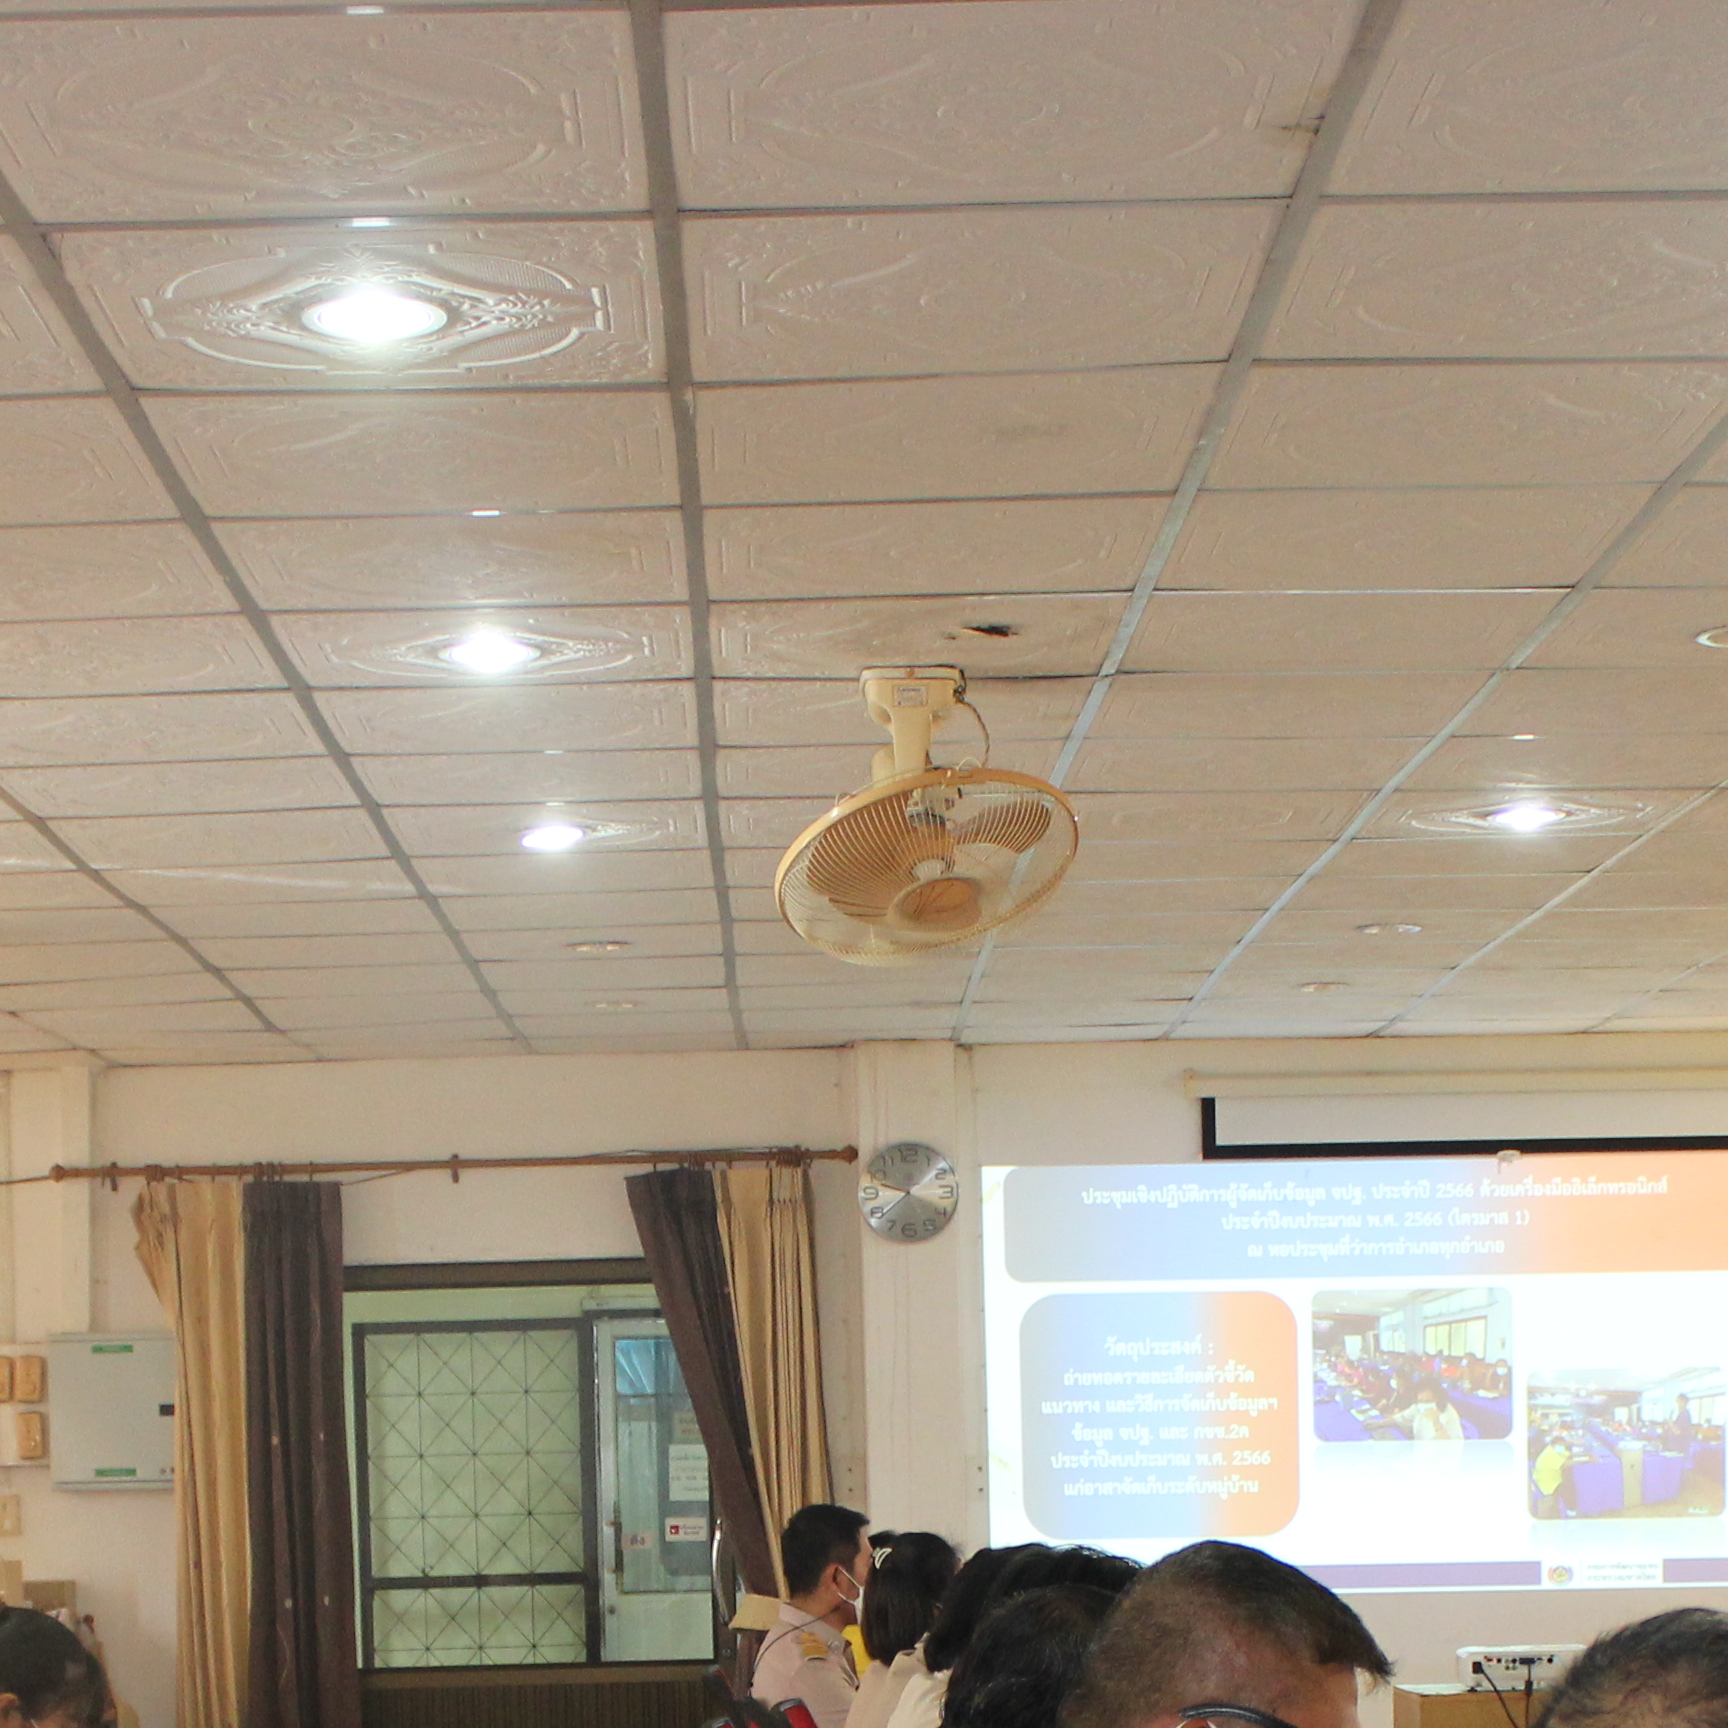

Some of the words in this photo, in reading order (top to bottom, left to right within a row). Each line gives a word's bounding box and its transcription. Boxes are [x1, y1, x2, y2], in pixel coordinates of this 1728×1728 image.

[898, 1148, 919, 1163] 12
[935, 1168, 947, 1180] 2
[863, 1185, 879, 1200] 9
[939, 1184, 954, 1199] 3
[1372, 1180, 1430, 1200] ประจำปี
[1436, 1183, 1474, 1199] 2566
[1480, 1174, 1668, 1198] ด้วยเครื่องมืออิเล็กทรอนิกส์
[934, 1207, 947, 1218] 4
[1221, 1210, 1362, 1230] ประจำปีงบประมาณ
[1368, 1211, 1399, 1228] พ.ศ.
[1404, 1211, 1443, 1227] 2566
[1448, 1206, 1508, 1228] (ไตรมาส
[1514, 1209, 1530, 1227] 1)
[886, 1219, 897, 1232] 7
[901, 1222, 918, 1238] 6
[923, 1219, 937, 1232] 5
[1247, 1244, 1263, 1258] ณ
[1269, 1233, 1505, 1262] หอประชุมที่ว่าการอำเภอทุกอำเภอ
[1105, 1335, 1202, 1361] วัตถุประสงค์
[1064, 1360, 1254, 1385] ถ่ายทอดรายละเอียดตัวชี้วัด
[1041, 1397, 1101, 1414] แนวทาง
[1071, 1421, 1114, 1448] ข้อมูล
[1159, 1426, 1189, 1441] และ
[1050, 1449, 1190, 1469] ประจำปีงบประมาณ
[1195, 1451, 1227, 1468] พ.ศ.
[1232, 1450, 1271, 1466] 2566
